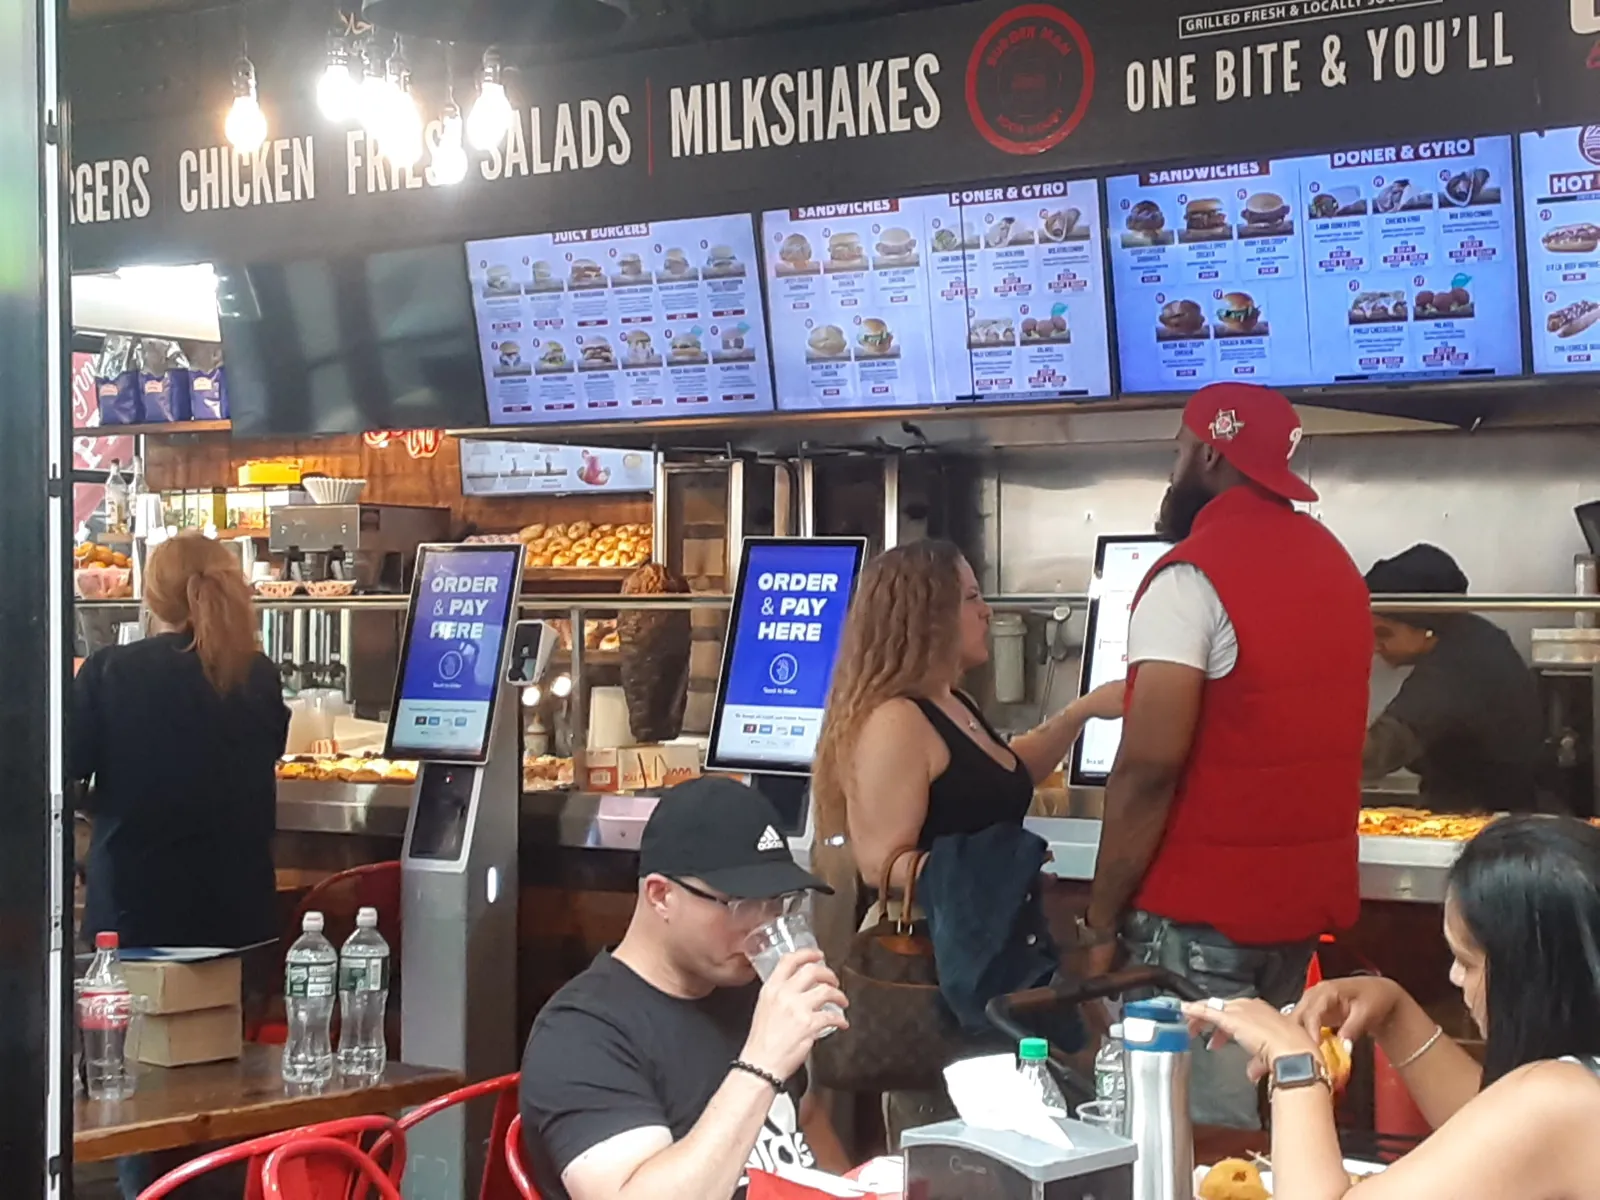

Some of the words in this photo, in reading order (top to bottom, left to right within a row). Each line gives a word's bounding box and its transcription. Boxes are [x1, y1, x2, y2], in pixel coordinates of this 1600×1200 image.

[1185, 13, 1240, 31] GRILLED
[1244, 6, 1286, 23] FRESH
[1290, 4, 1300, 17] &
[1126, 54, 1197, 113] ONE
[1214, 39, 1302, 102] BITE
[1320, 34, 1348, 88] &
[1366, 11, 1515, 82] YOU'LL
[669, 52, 942, 159] MILKSHAKES
[346, 118, 440, 196] FRS
[1333, 147, 1397, 168] DONER
[1400, 146, 1414, 160] &
[1418, 140, 1472, 158] GYRO
[178, 134, 316, 214] CHICKEN
[1148, 161, 1261, 185] SANDWICHES
[1552, 174, 1595, 193] HOT
[1007, 186, 1019, 200] &
[1021, 182, 1065, 199] GYRO
[798, 200, 892, 219] SANDWICHES
[553, 228, 589, 244] JUICY
[590, 223, 648, 239] BURGERS
[430, 576, 499, 594] ORDER
[758, 572, 839, 593] ORDER
[433, 600, 444, 617] &
[448, 599, 490, 616] PAY
[761, 597, 775, 616] &
[780, 597, 828, 617] PAY
[429, 622, 485, 640] HERE
[757, 622, 823, 642] HERE
